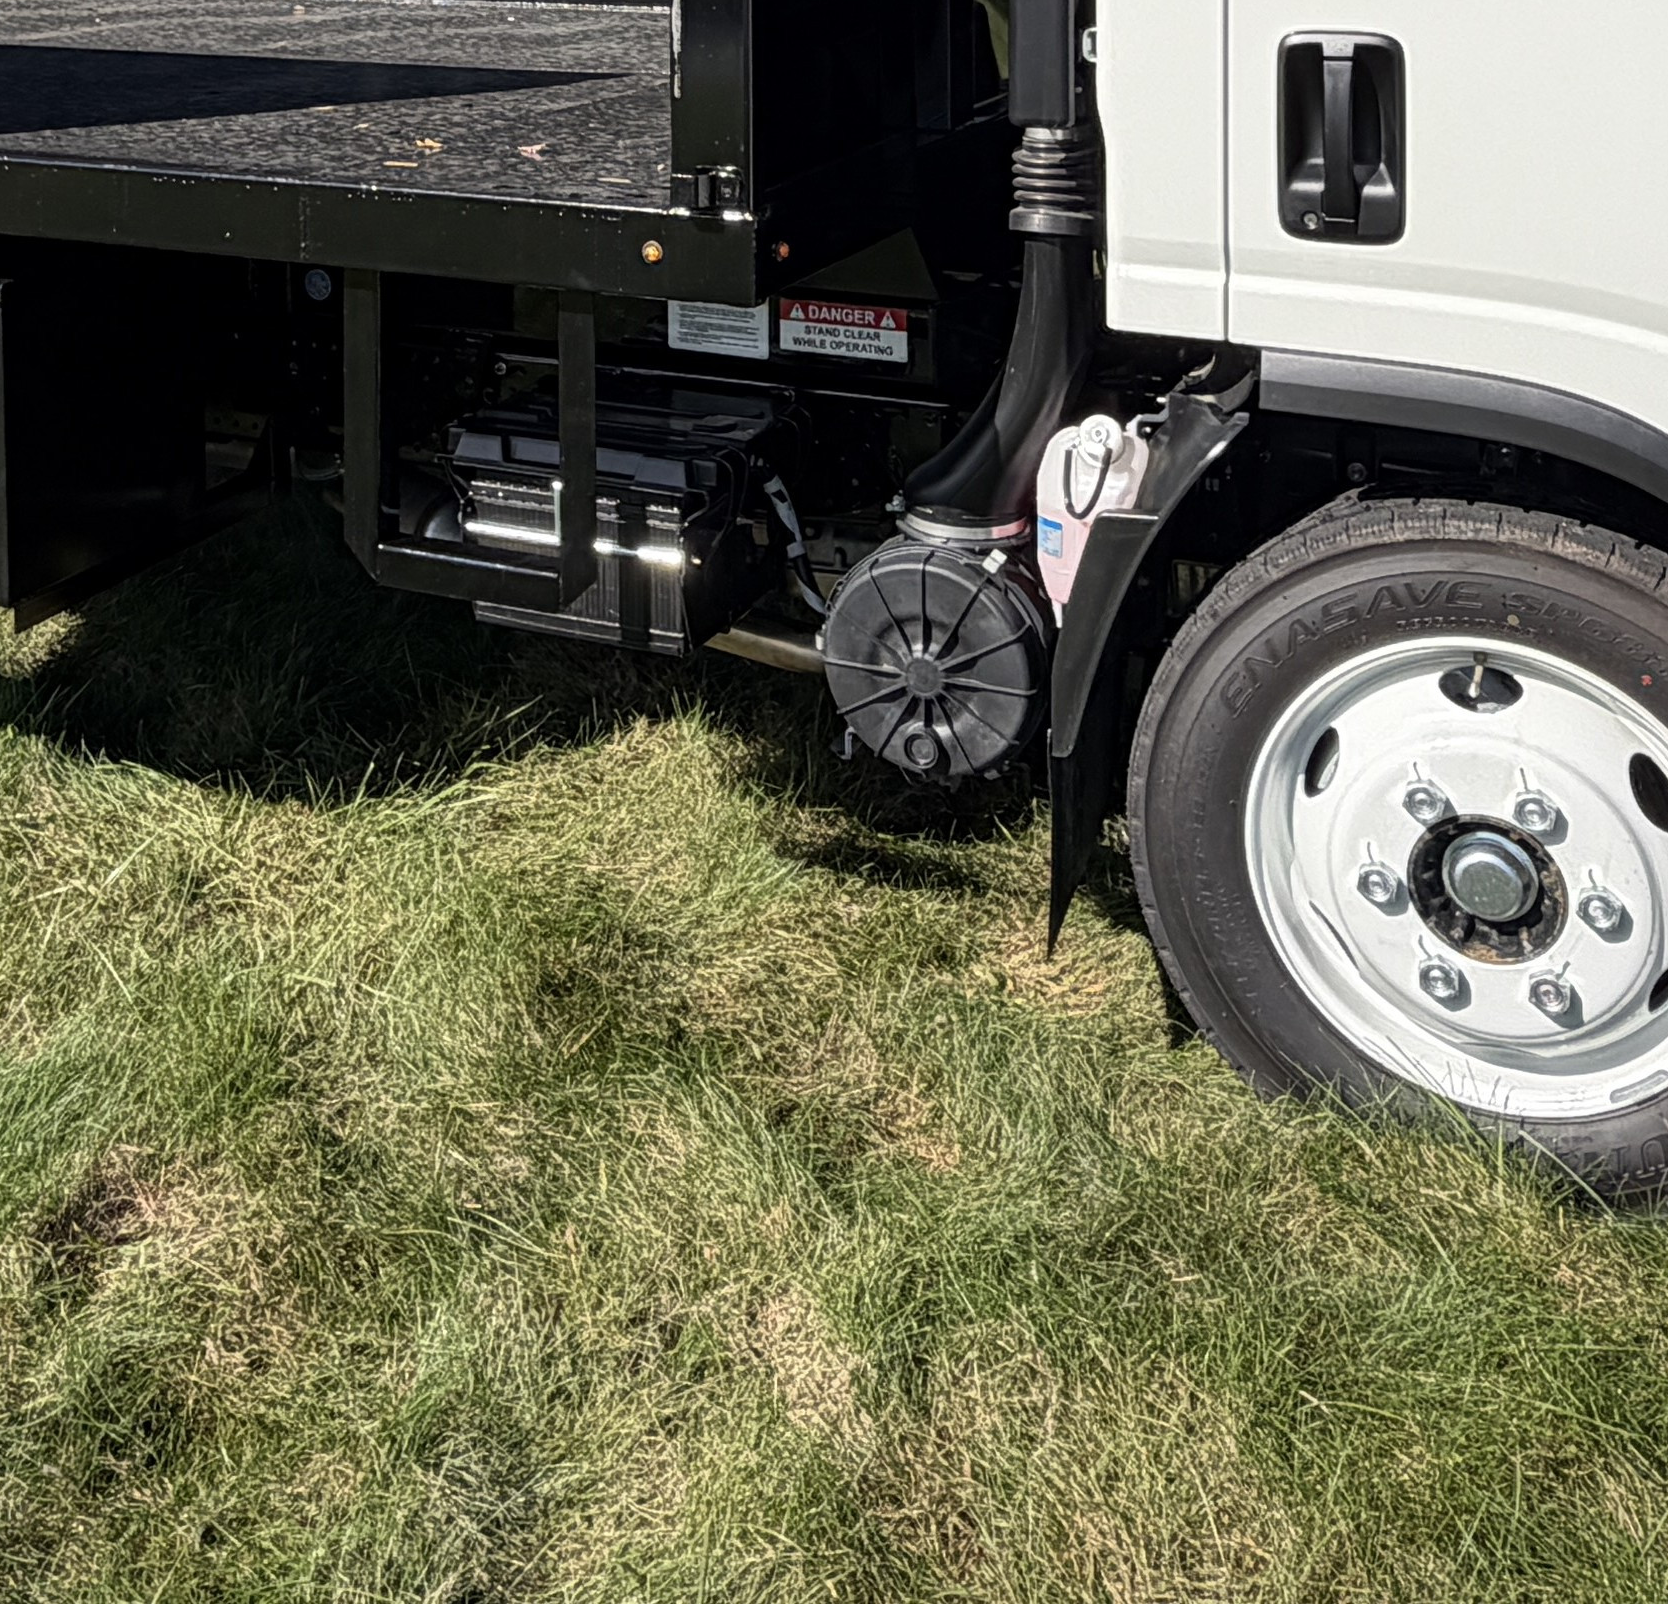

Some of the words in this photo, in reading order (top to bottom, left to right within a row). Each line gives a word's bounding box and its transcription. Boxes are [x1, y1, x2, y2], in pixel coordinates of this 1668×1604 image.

[808, 304, 876, 326] DANGER
[804, 325, 841, 338] STAND
[843, 329, 881, 342] CLEAR
[792, 336, 827, 349] WHILE
[829, 340, 894, 356] OPERATING
[1219, 579, 1493, 719] ENASAVE
